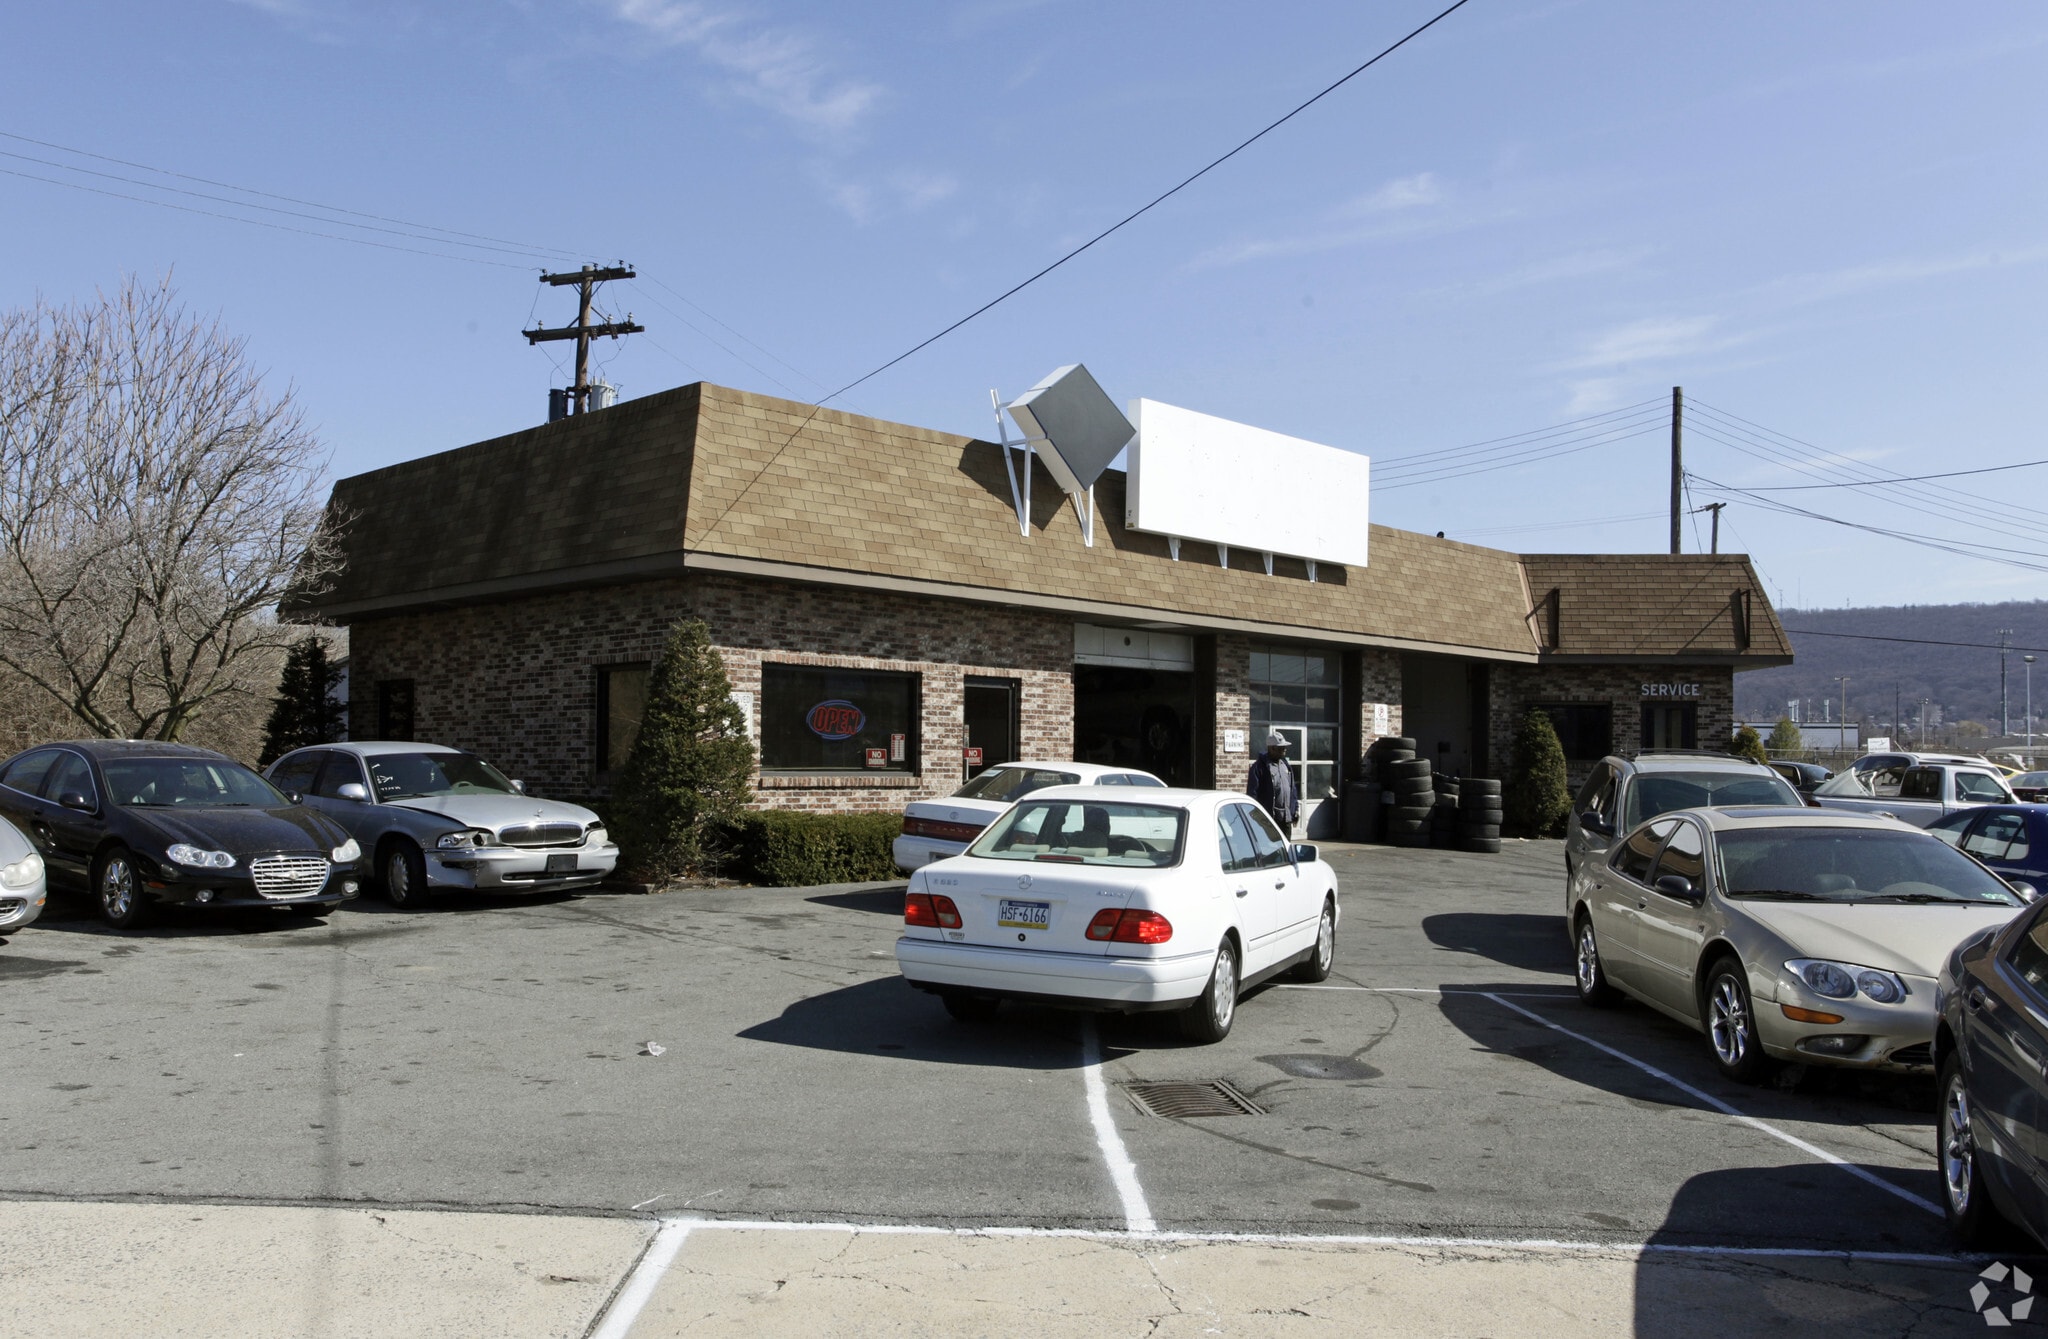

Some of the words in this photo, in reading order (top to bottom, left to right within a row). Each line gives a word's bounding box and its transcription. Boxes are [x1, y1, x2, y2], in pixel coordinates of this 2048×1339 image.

[1641, 684, 1700, 696] SERVICE
[813, 706, 859, 735] OPEN
[872, 750, 882, 759] NO
[968, 749, 978, 757] NO
